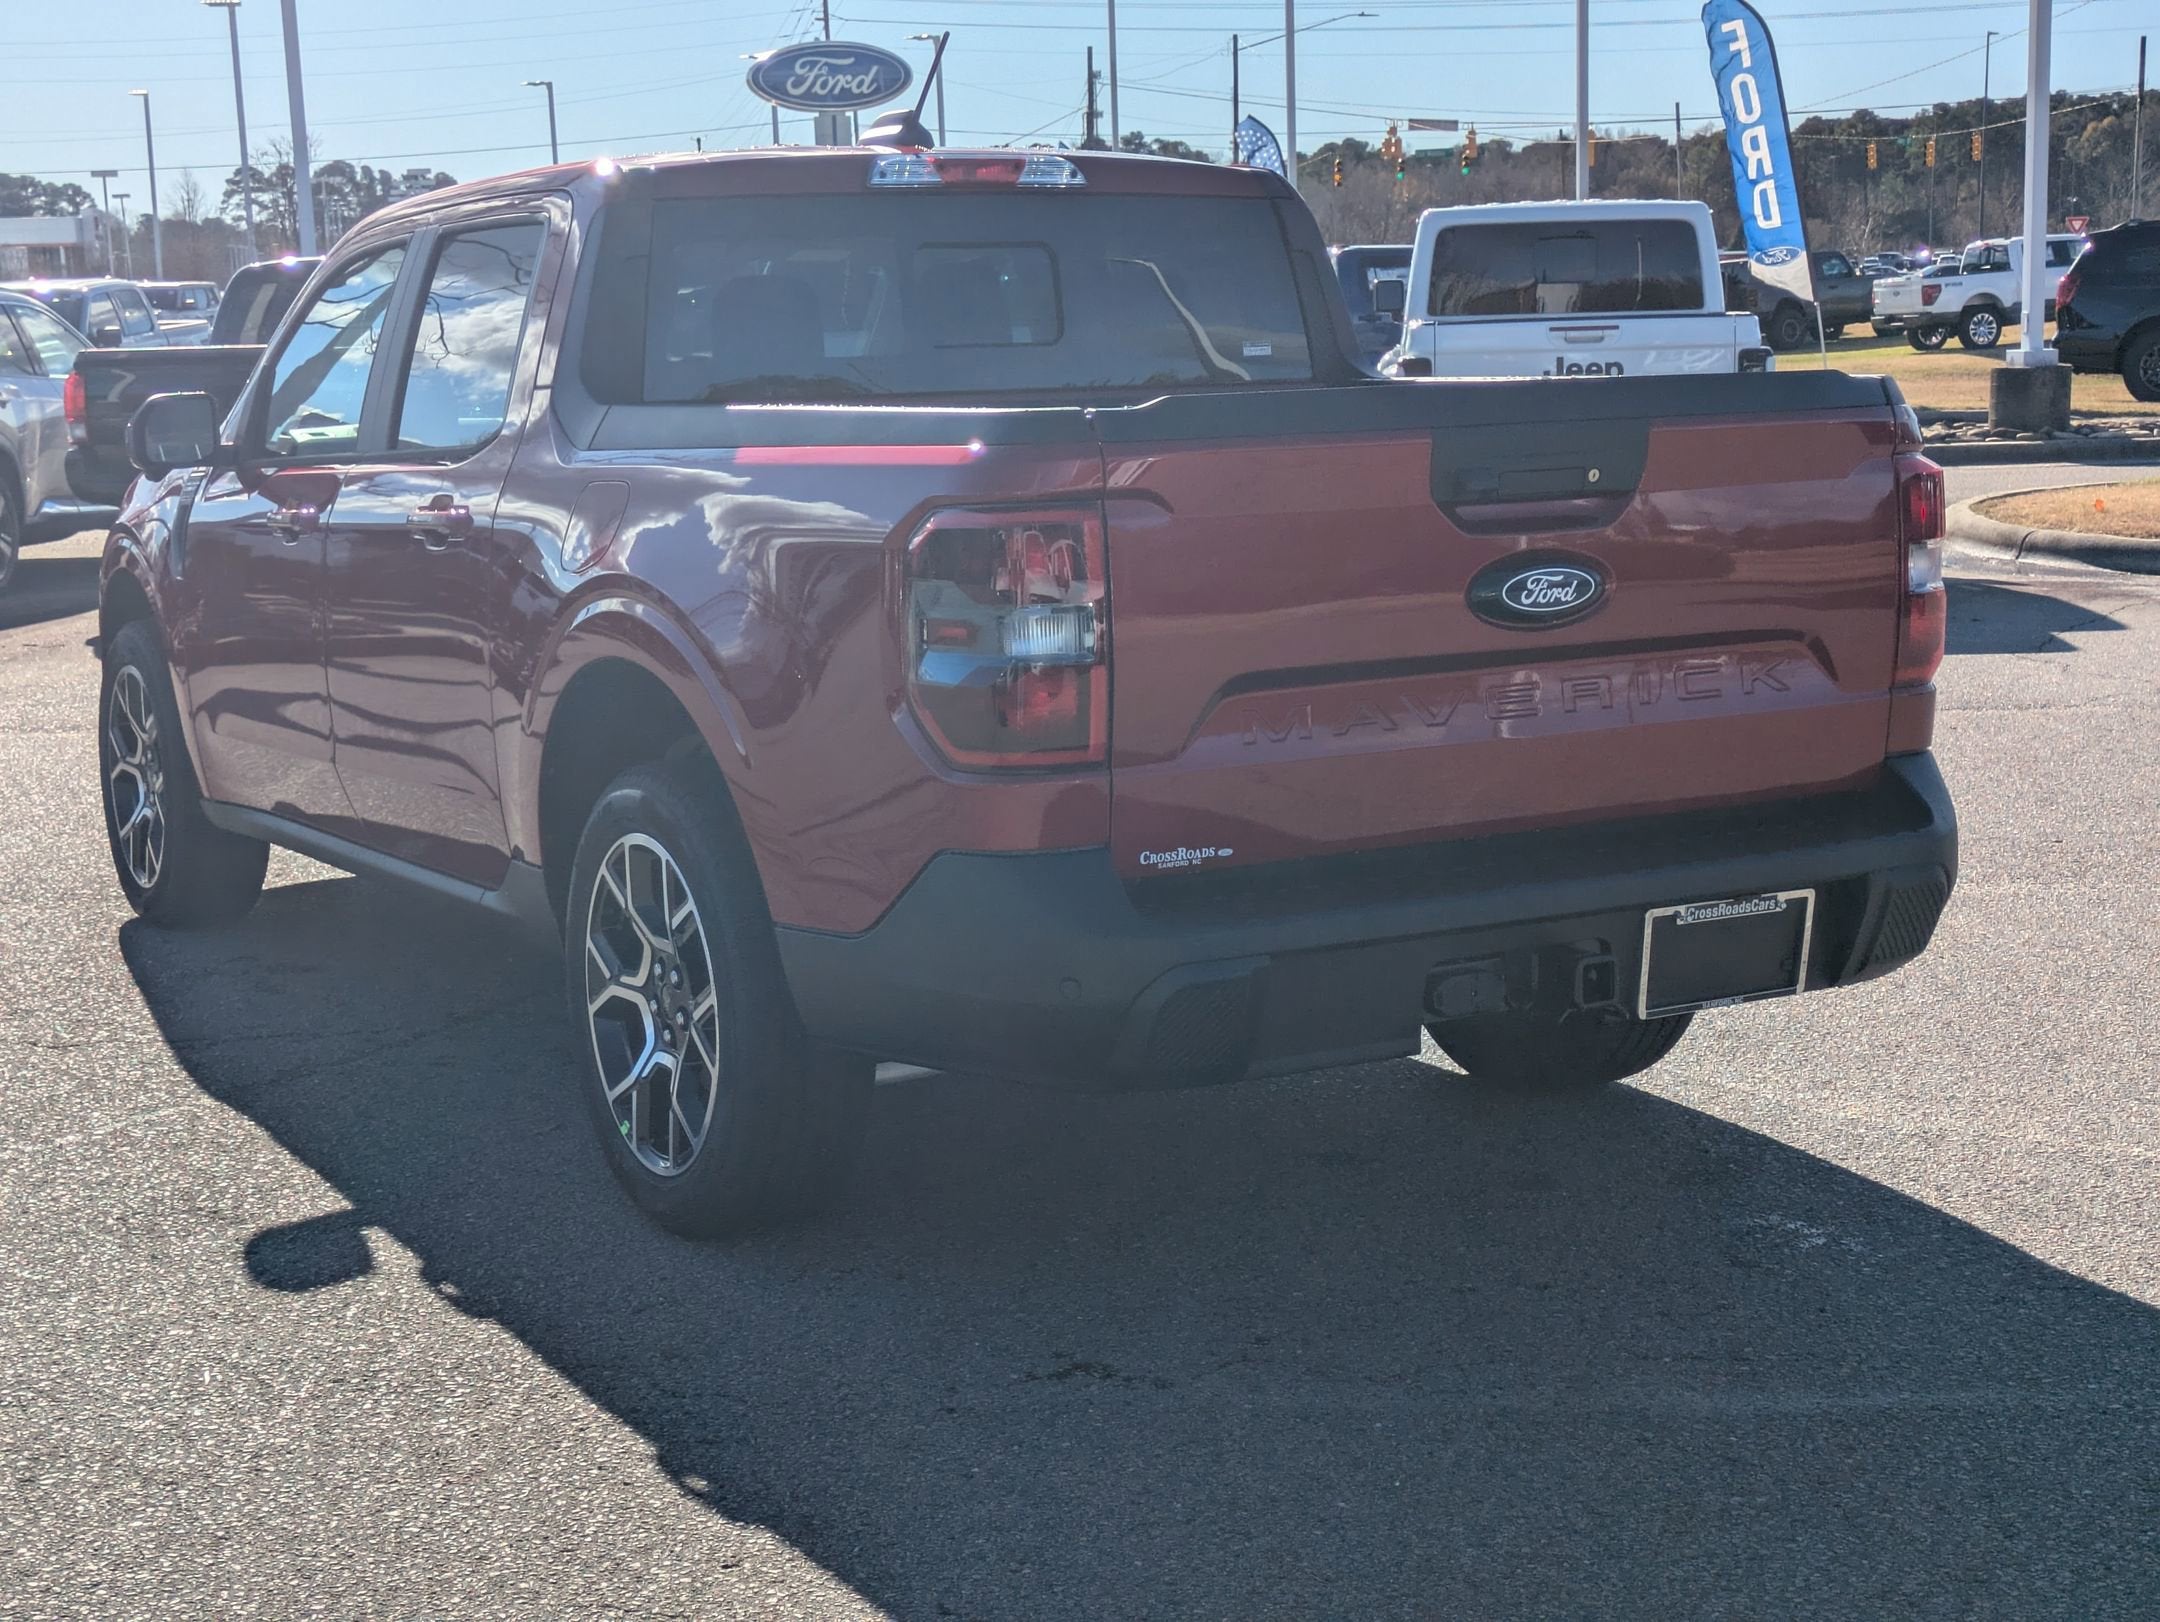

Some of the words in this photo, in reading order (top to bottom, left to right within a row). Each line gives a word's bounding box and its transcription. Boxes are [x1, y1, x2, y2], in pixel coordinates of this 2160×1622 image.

[786, 57, 878, 96] Ford
[1521, 575, 1577, 604] Ford
[1242, 658, 1791, 745] MAVERICK
[1158, 860, 1190, 869] SANFORD
[1687, 899, 1776, 920] CrossRoadsCars
